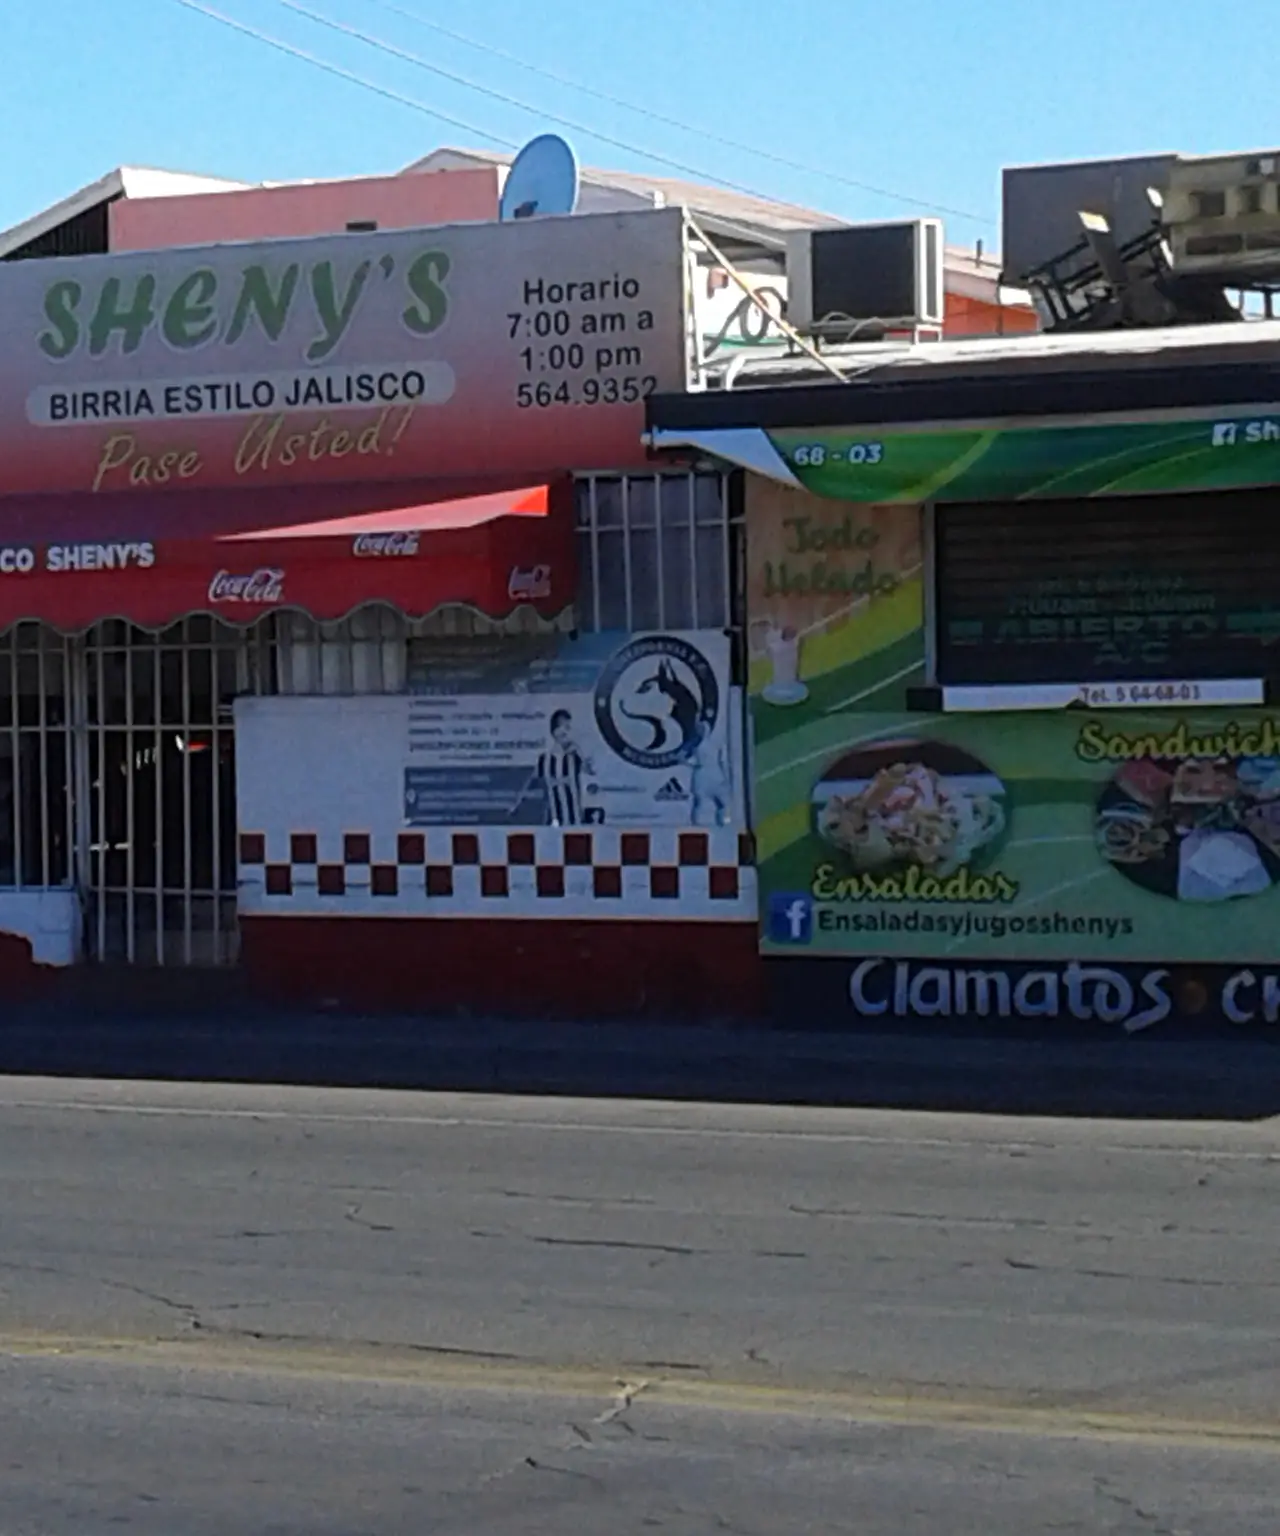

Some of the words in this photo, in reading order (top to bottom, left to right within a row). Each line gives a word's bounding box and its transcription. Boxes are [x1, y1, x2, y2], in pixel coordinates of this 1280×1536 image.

[523, 272, 640, 305] Horario
[506, 310, 570, 339] 7:00
[581, 312, 625, 334] am
[637, 310, 654, 330] a
[520, 343, 584, 372] 1:00
[596, 346, 641, 373] pm
[49, 384, 156, 420] BIRRIA
[164, 379, 274, 415] ESTILO
[284, 370, 426, 407] JALISCO
[516, 375, 658, 408] 564.9352
[1245, 420, 1280, 442] Sh
[92, 434, 204, 493] Pase
[234, 404, 415, 476] Usted!
[794, 445, 825, 466] 68
[849, 444, 882, 465] 03
[46, 543, 154, 572] SHENY'S
[818, 909, 1134, 938] Ensaladasyjugosshenys
[849, 958, 1171, 1034] Clamatos
